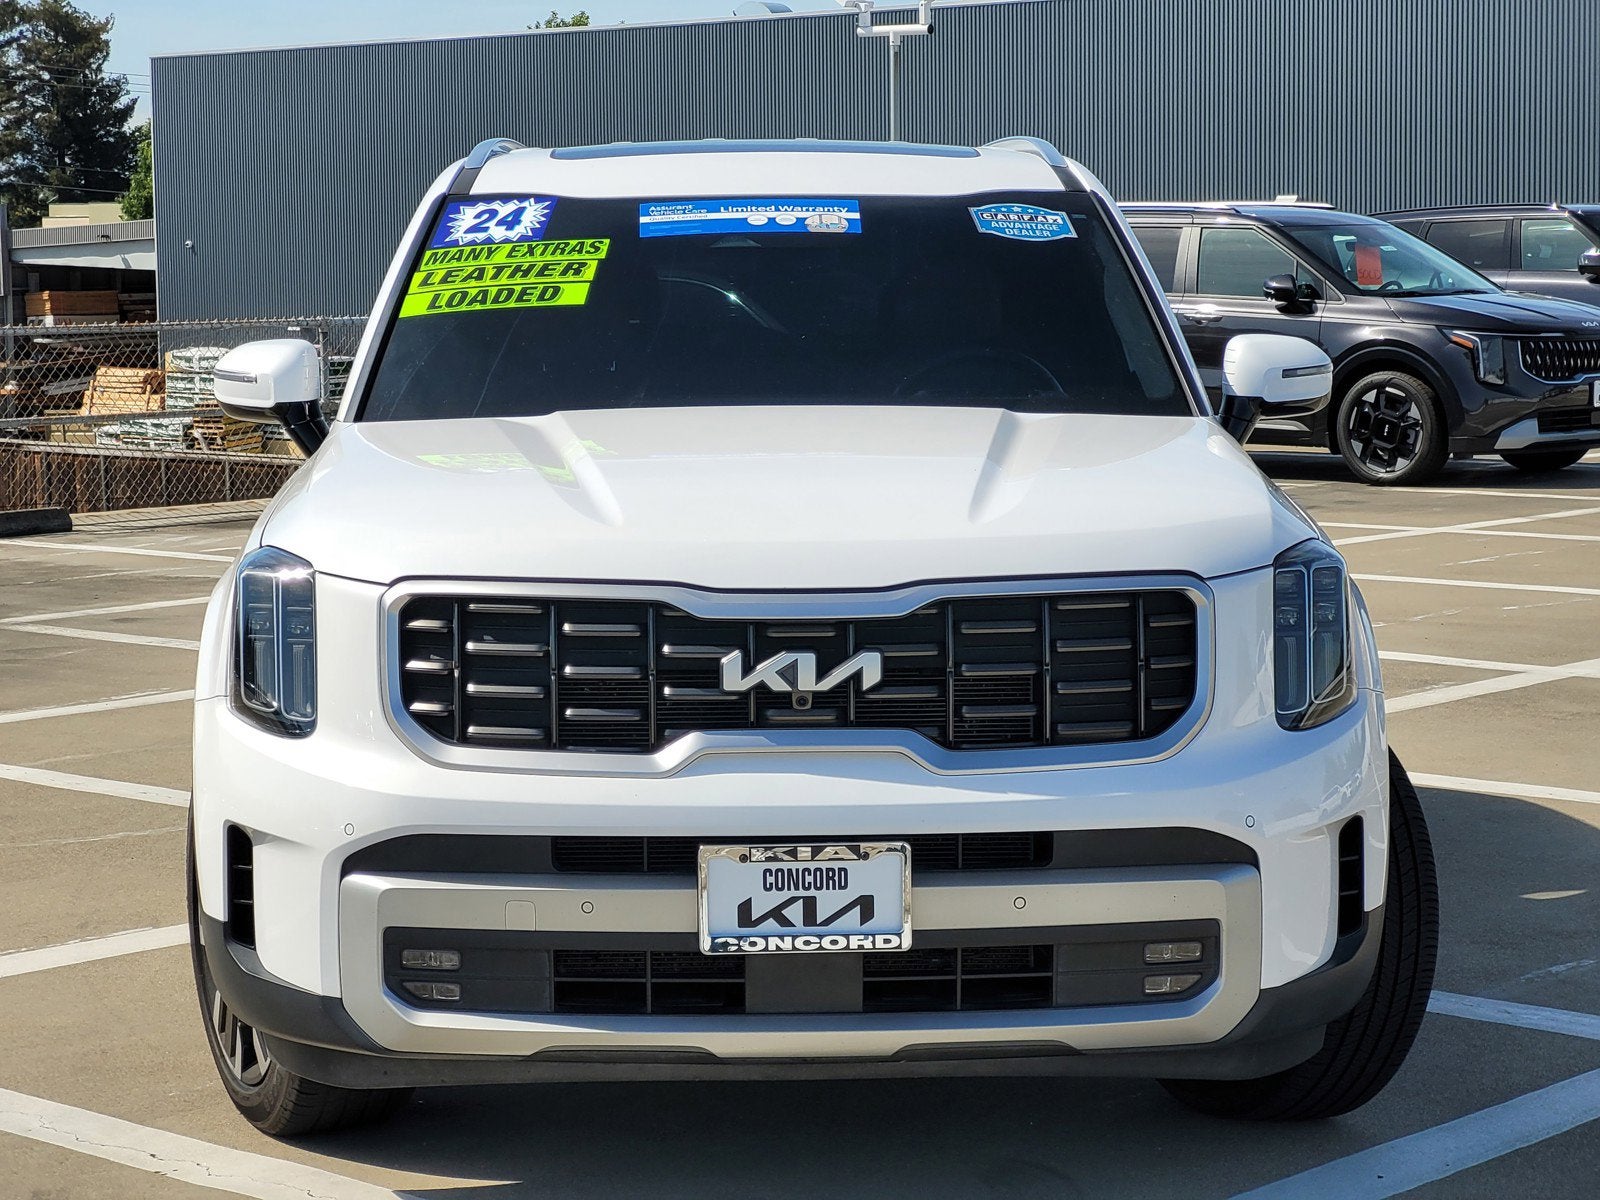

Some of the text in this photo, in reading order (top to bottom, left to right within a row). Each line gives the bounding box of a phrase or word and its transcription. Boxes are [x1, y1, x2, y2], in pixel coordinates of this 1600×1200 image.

[463, 206, 528, 234] 24
[720, 205, 848, 214] Limited Warranty
[981, 213, 1062, 224] CARFAX
[991, 221, 1060, 231] ADVANTAGE
[1005, 228, 1051, 237] DEALER
[424, 240, 604, 267] MANY EXTRAS
[418, 261, 589, 288] LEATHER
[426, 285, 564, 312] LOADED
[720, 650, 881, 691] KIA
[751, 846, 859, 862] KIA
[762, 866, 849, 892] CONCORD
[737, 894, 875, 929] KIA
[713, 935, 901, 952] CONCORD
